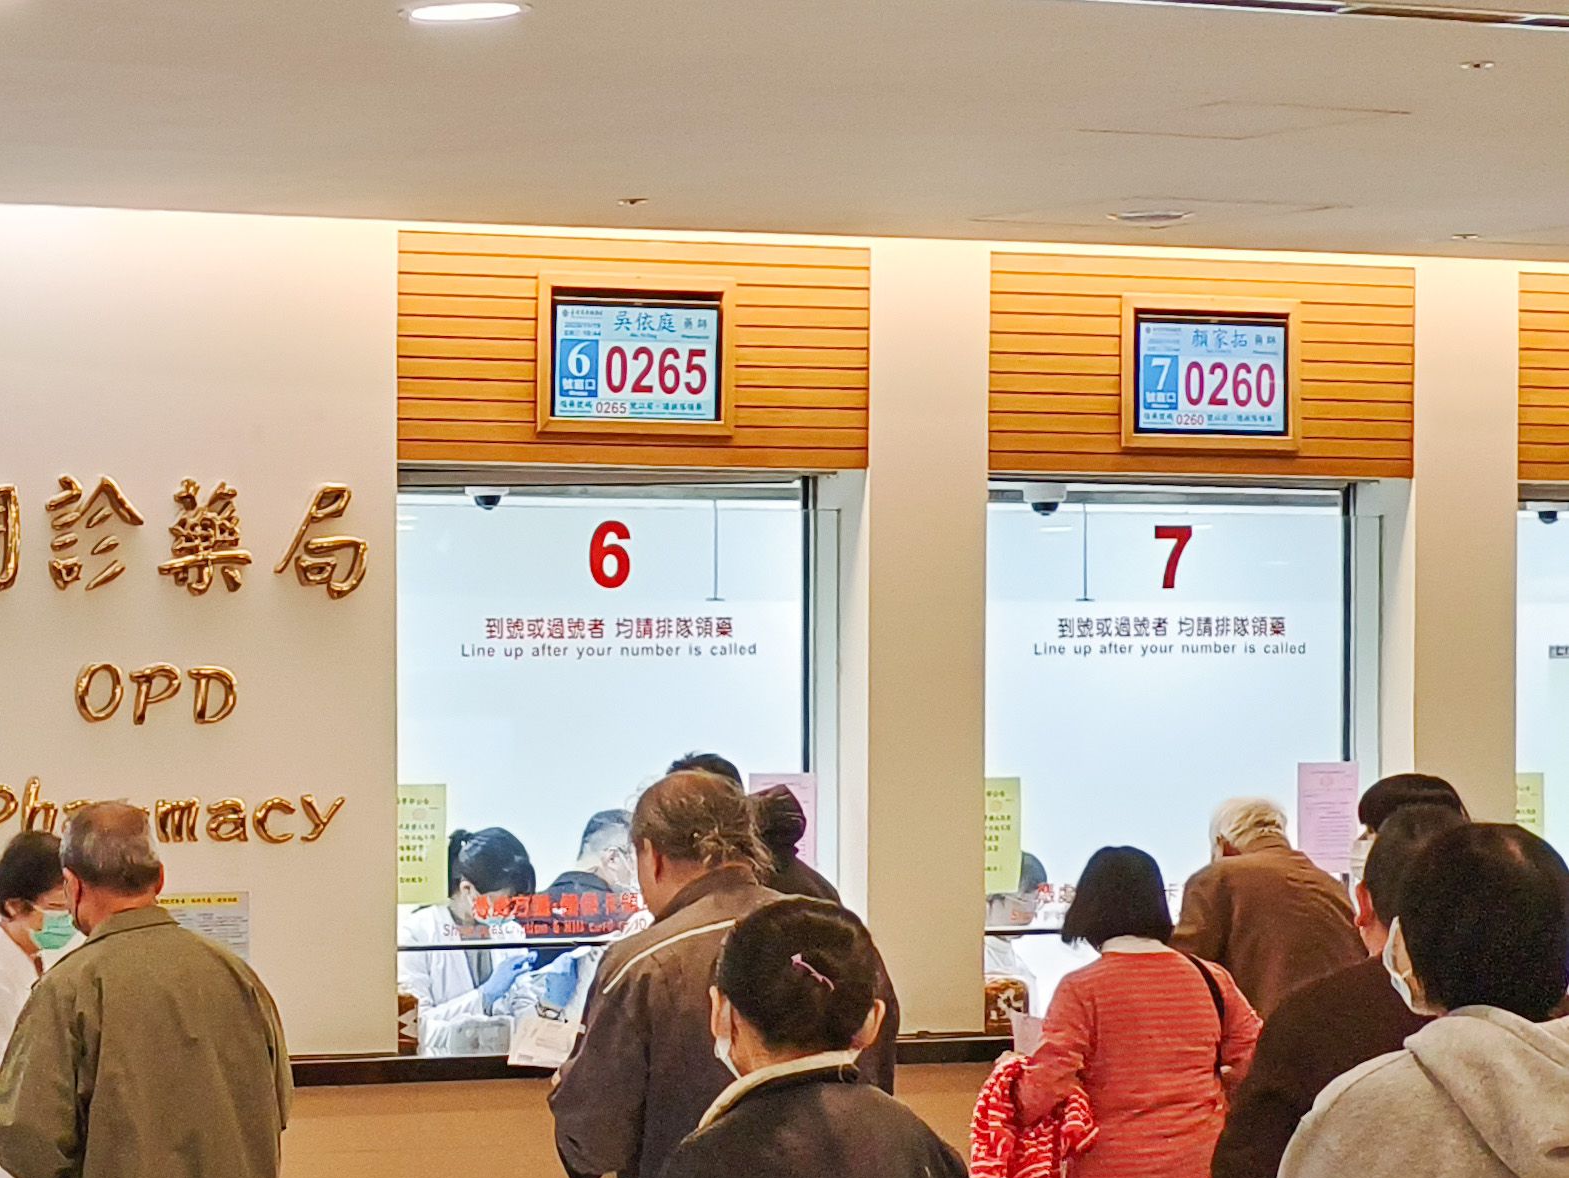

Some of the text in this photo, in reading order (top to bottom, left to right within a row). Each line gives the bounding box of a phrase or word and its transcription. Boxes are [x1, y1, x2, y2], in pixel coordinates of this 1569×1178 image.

[567, 341, 591, 377] 6
[605, 345, 707, 395] 0265
[1151, 357, 1171, 390] 7
[1185, 361, 1275, 408] 0260
[595, 401, 627, 414] 0265
[1176, 414, 1205, 425] 0260
[589, 520, 631, 588] 6
[1154, 525, 1192, 589] 7
[461, 643, 757, 660] Line up after your number is called
[1033, 642, 1306, 657] Line up after your number is called
[74, 661, 238, 725] OPD
